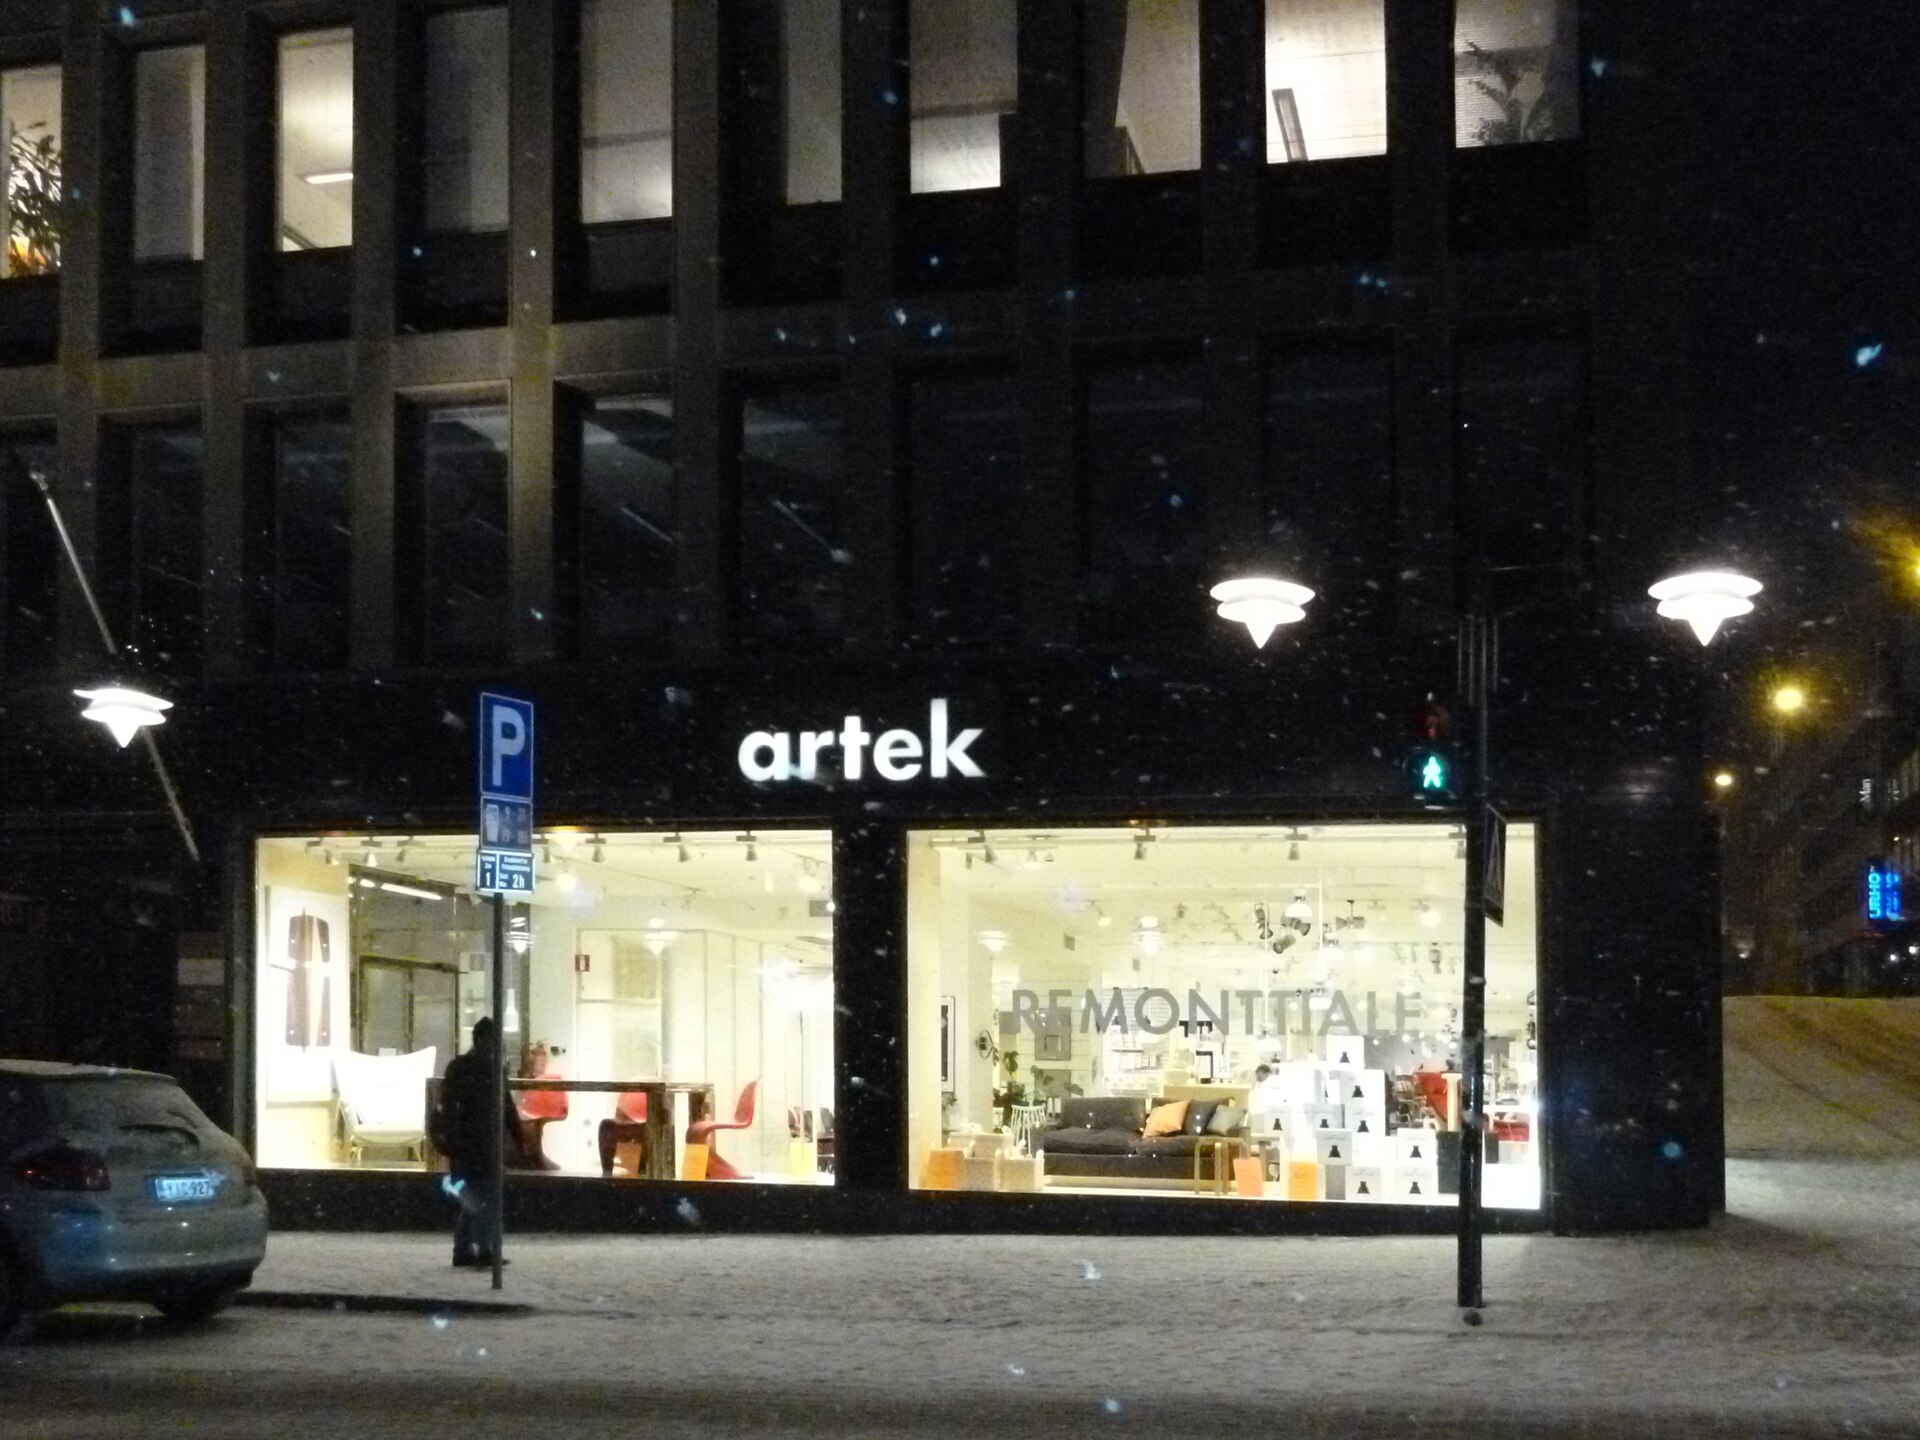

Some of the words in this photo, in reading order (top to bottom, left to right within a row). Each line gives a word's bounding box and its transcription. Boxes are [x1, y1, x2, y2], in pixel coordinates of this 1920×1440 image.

[492, 704, 526, 786] P
[738, 698, 987, 782] artek
[1868, 873, 1881, 919] URHO
[1012, 987, 1422, 1037] REMONTTIALE
